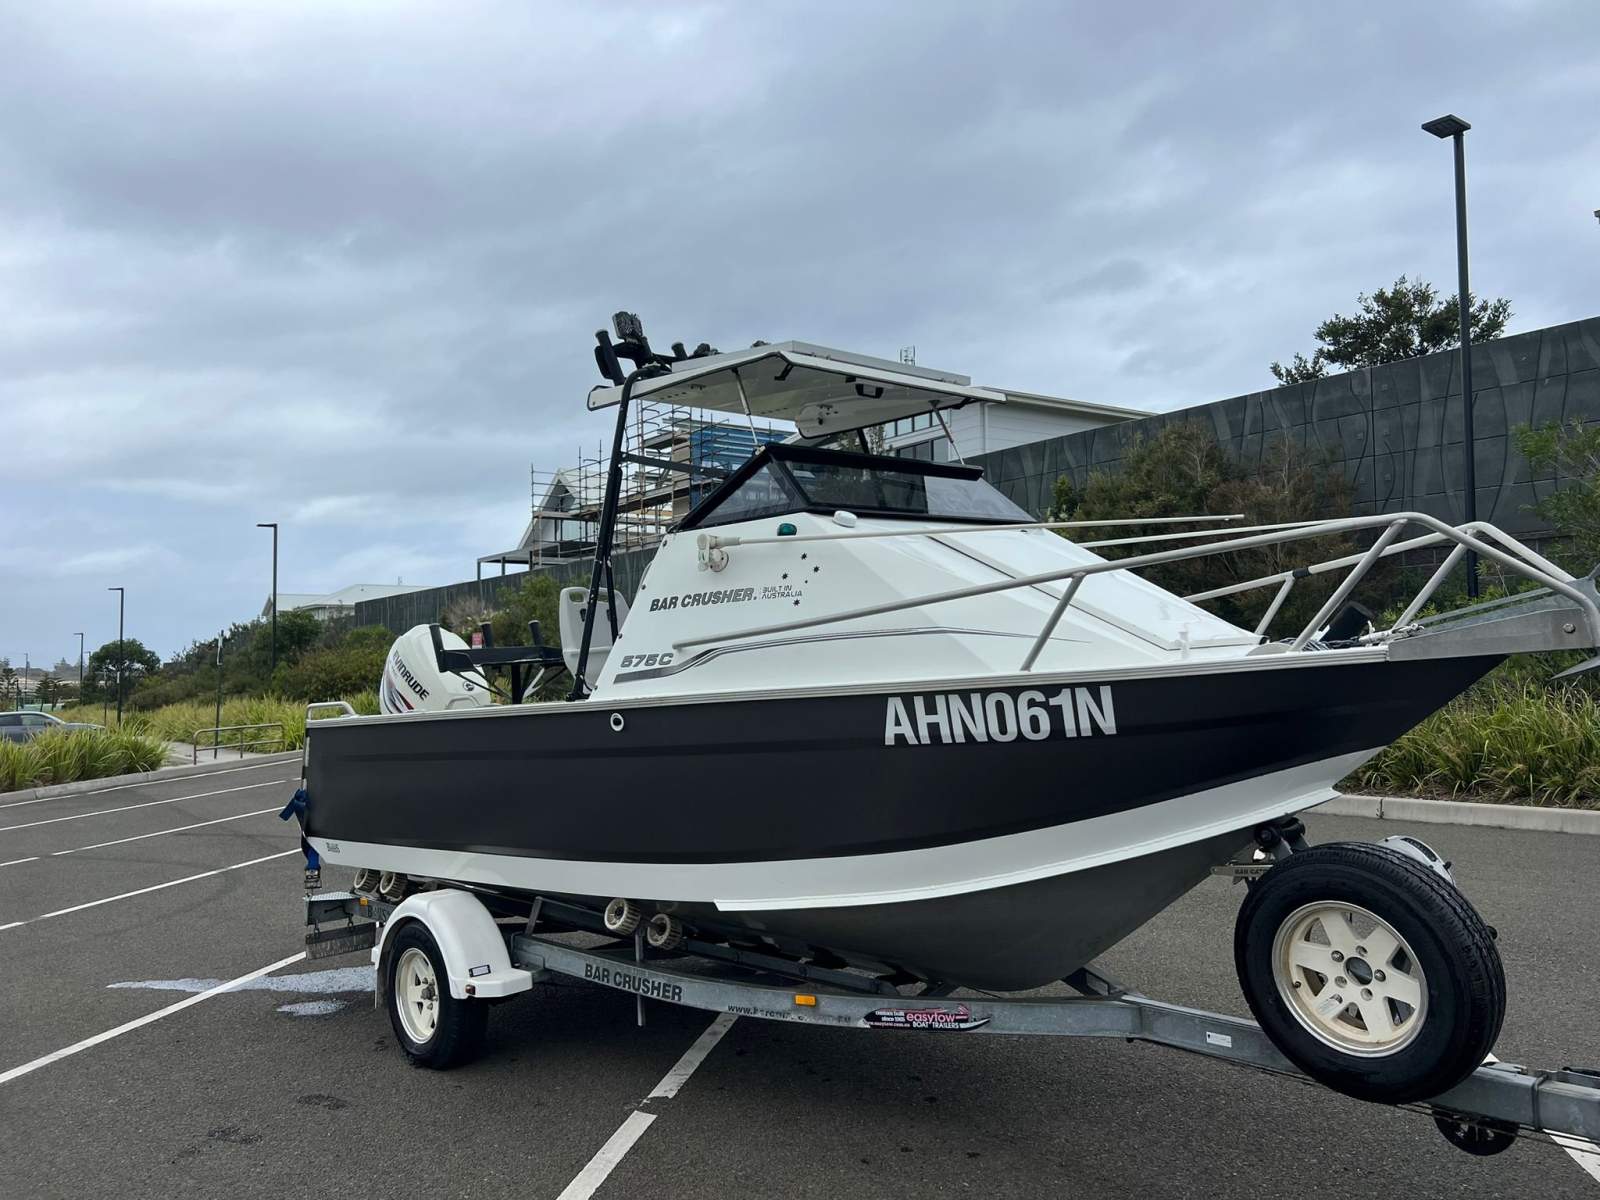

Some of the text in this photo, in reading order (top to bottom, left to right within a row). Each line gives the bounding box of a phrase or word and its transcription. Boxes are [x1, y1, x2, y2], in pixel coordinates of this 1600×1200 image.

[649, 587, 755, 612] BAR CRUSHER
[761, 590, 802, 599] AUSTRALIA
[620, 652, 674, 668] 575C
[885, 685, 1117, 746] AHN061N
[584, 963, 682, 1002] BAR CRUSHER
[906, 1011, 956, 1025] easytow
[912, 1020, 960, 1029] BOAT TRAILERS
